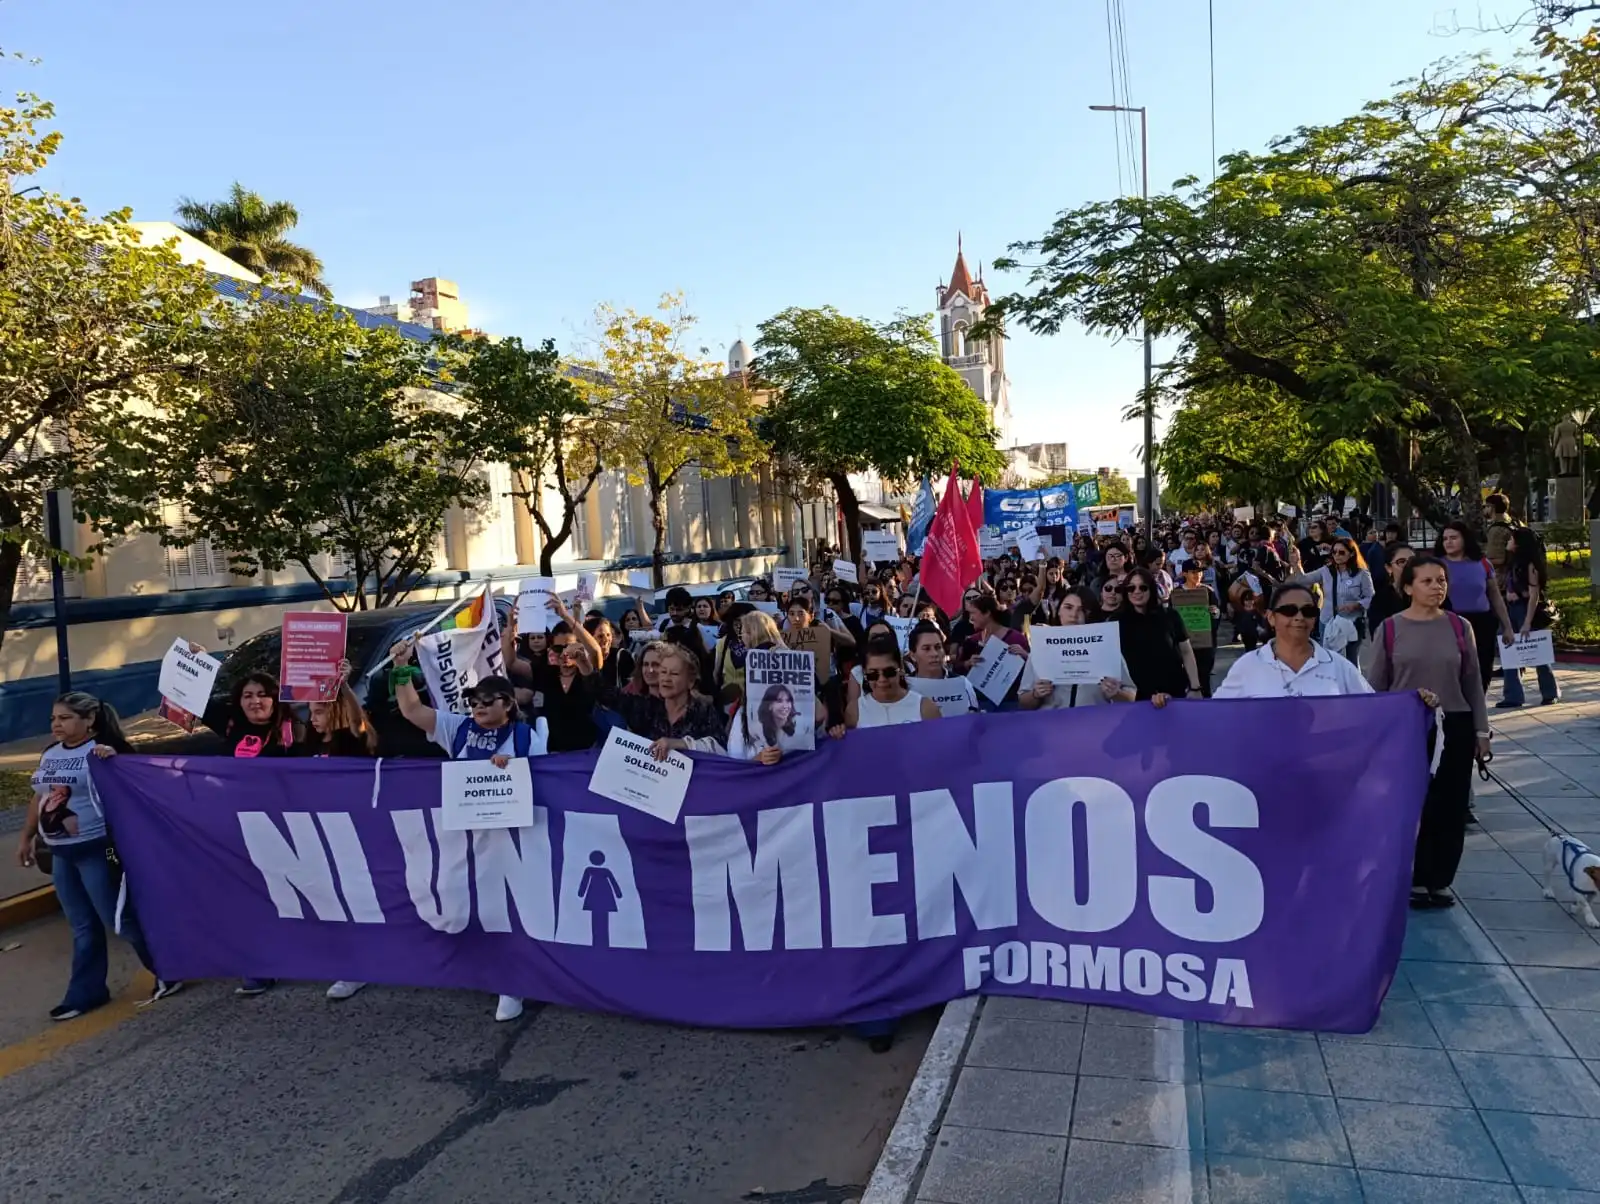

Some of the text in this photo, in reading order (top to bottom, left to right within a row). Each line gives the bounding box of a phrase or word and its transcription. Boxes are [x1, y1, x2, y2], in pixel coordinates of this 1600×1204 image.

[1045, 635, 1104, 645] RODRIGUEZ
[749, 651, 811, 671] CRISTINA
[749, 670, 811, 685] LIBRE
[931, 694, 964, 703] LOPEZ
[623, 755, 668, 777] SOLEDAD
[466, 774, 512, 784] XIOMARA
[464, 788, 513, 798] PORTILLO
[236, 774, 1265, 952] NI UNA MENOS
[962, 940, 1254, 1009] FORMOSA
